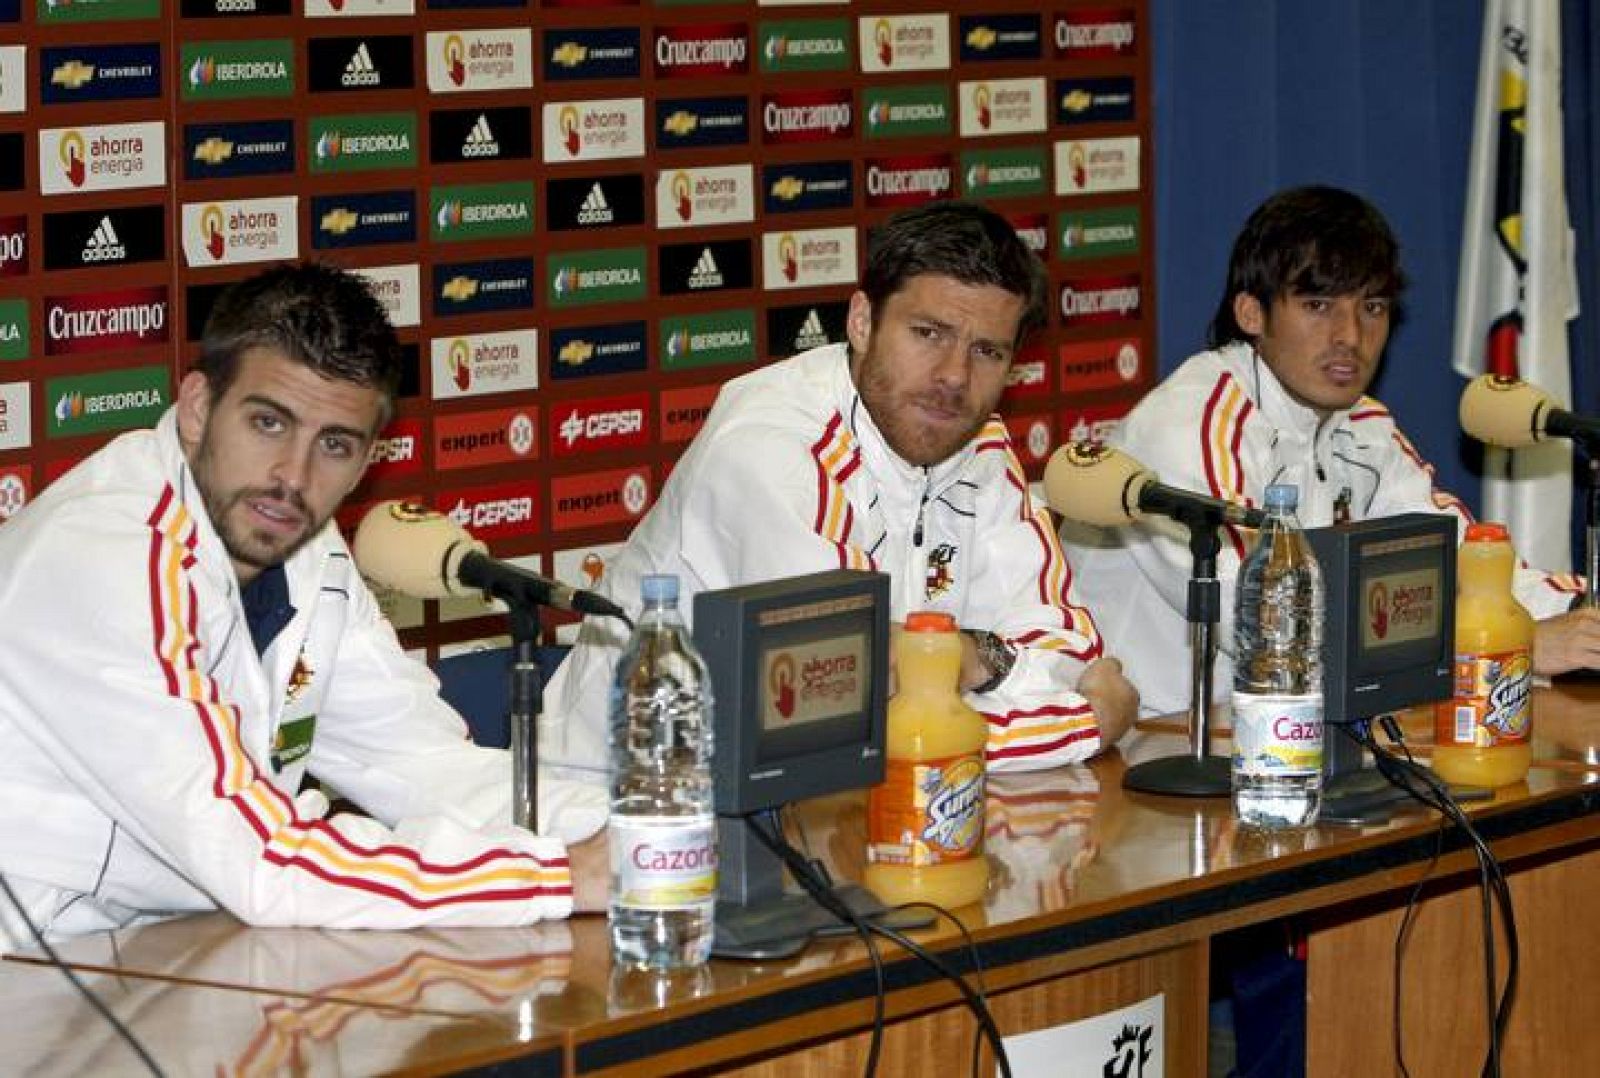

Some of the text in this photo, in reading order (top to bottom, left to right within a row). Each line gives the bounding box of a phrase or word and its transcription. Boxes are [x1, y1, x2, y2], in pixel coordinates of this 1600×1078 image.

[469, 40, 513, 57] ahorra
[657, 36, 745, 68] Cruzcampo
[100, 65, 151, 79] CHEVROLET
[217, 61, 287, 81] IBERDROLA
[342, 70, 380, 85] adidas
[584, 112, 627, 128] ahorra
[765, 103, 850, 133] Cruzcampo
[91, 137, 143, 156] ahorra
[342, 134, 410, 152] IBERDROLA
[461, 141, 498, 157] adidas
[91, 157, 143, 177] energia
[229, 211, 276, 228] ahorra
[229, 230, 278, 249] energia
[82, 245, 125, 261] adidas
[49, 302, 163, 341] Cruzcampo
[474, 344, 518, 363] ahorra
[85, 390, 161, 414] IBERDROLA
[586, 409, 643, 436] CEPSA
[367, 437, 414, 463] PSA
[441, 429, 505, 452] expert
[558, 491, 620, 513] expert
[473, 497, 532, 527] CEPSA
